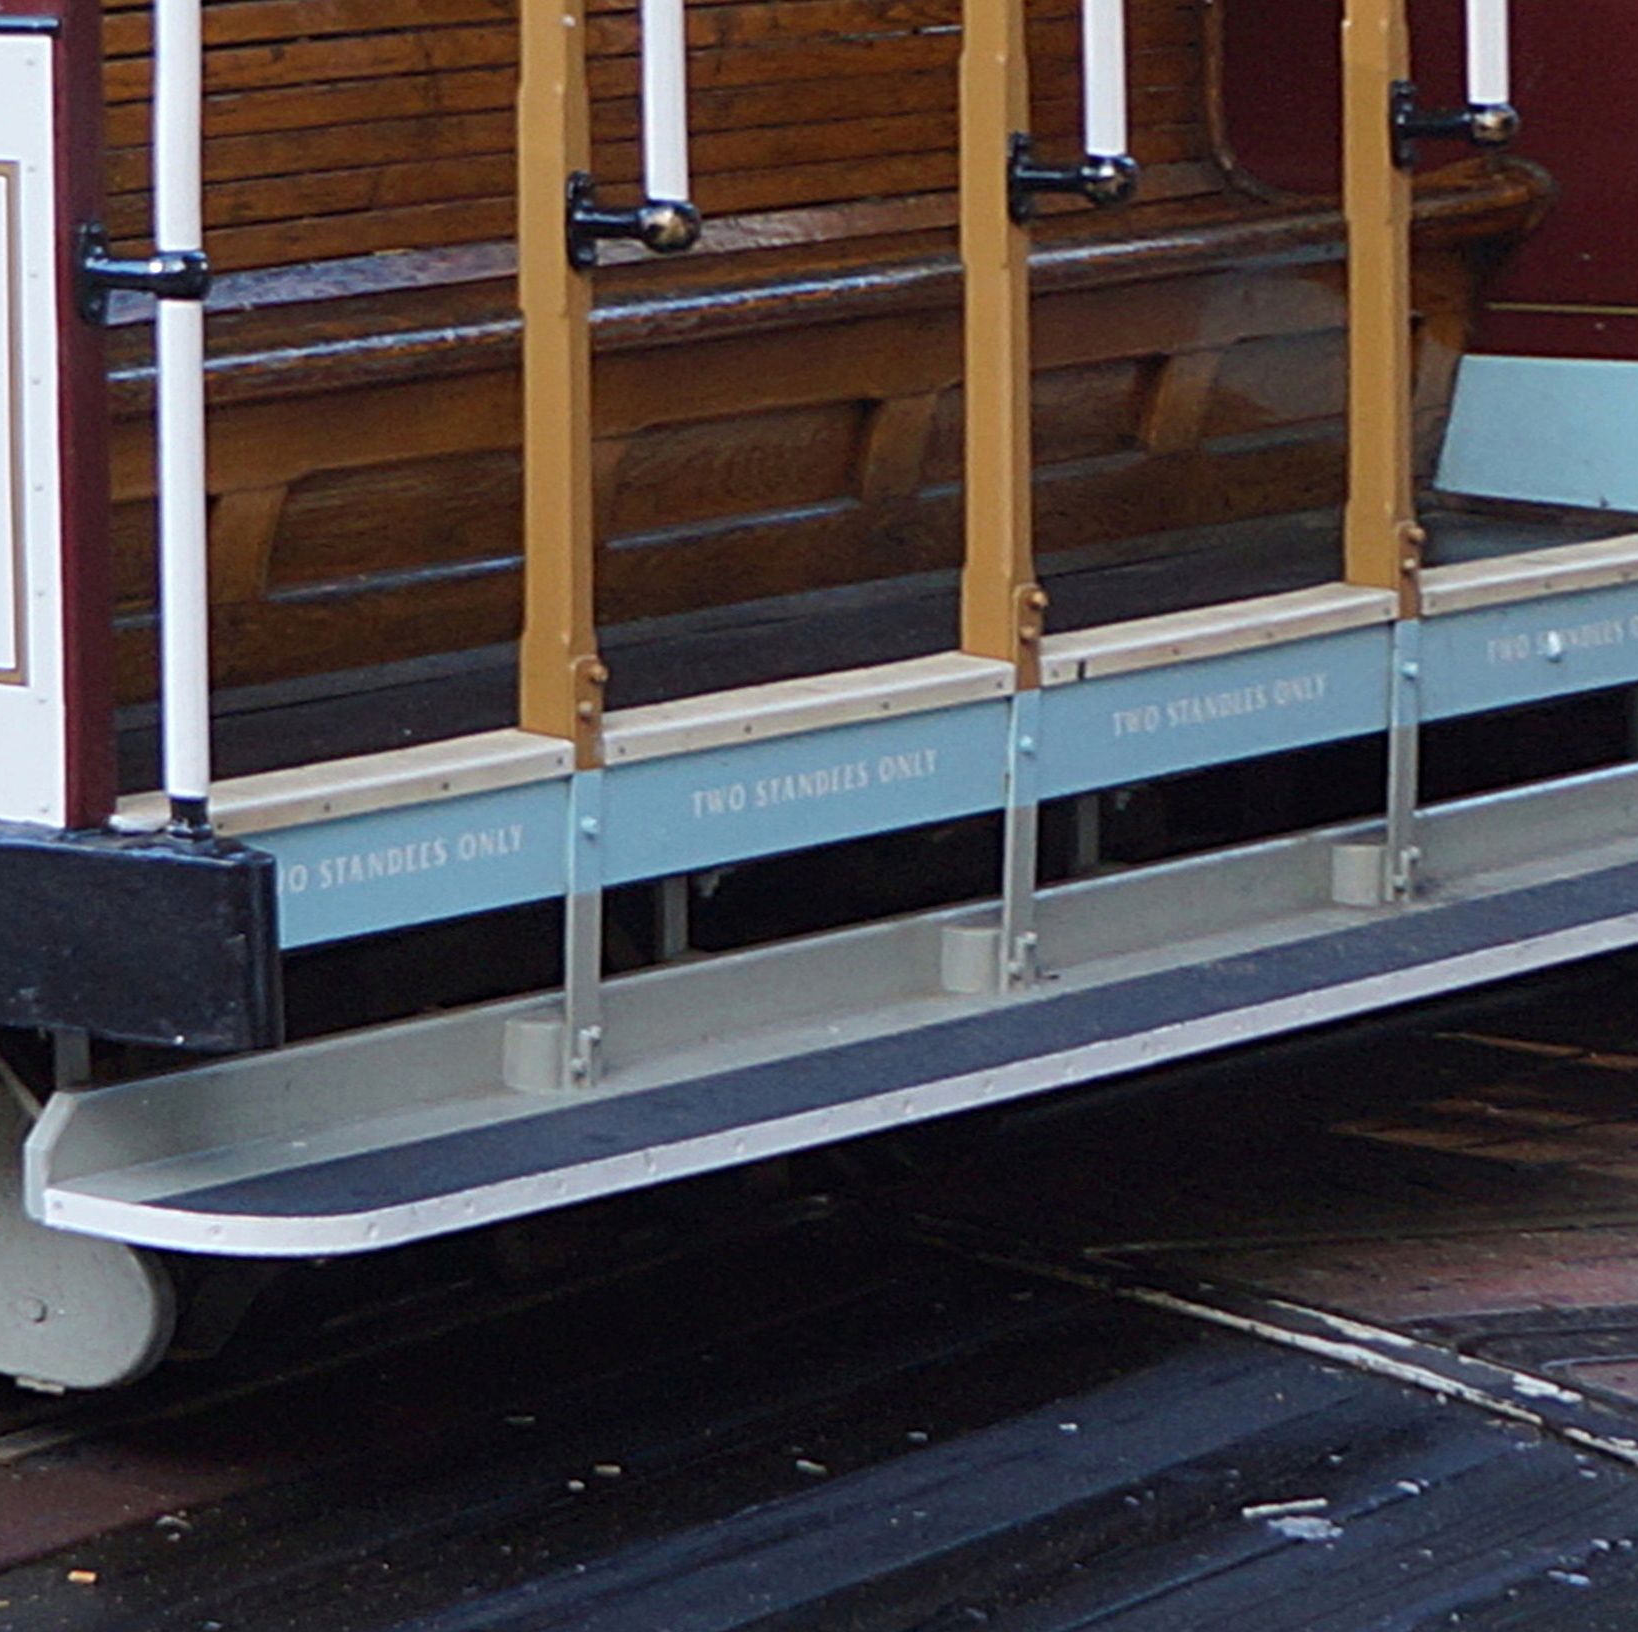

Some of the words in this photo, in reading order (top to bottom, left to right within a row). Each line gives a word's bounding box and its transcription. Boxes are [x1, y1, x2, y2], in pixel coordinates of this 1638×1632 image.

[691, 782, 746, 819] TWO
[756, 761, 868, 808] STANDEES
[878, 748, 937, 784] ONLY
[318, 835, 449, 890] STANDEES
[459, 824, 524, 862] ONLY
